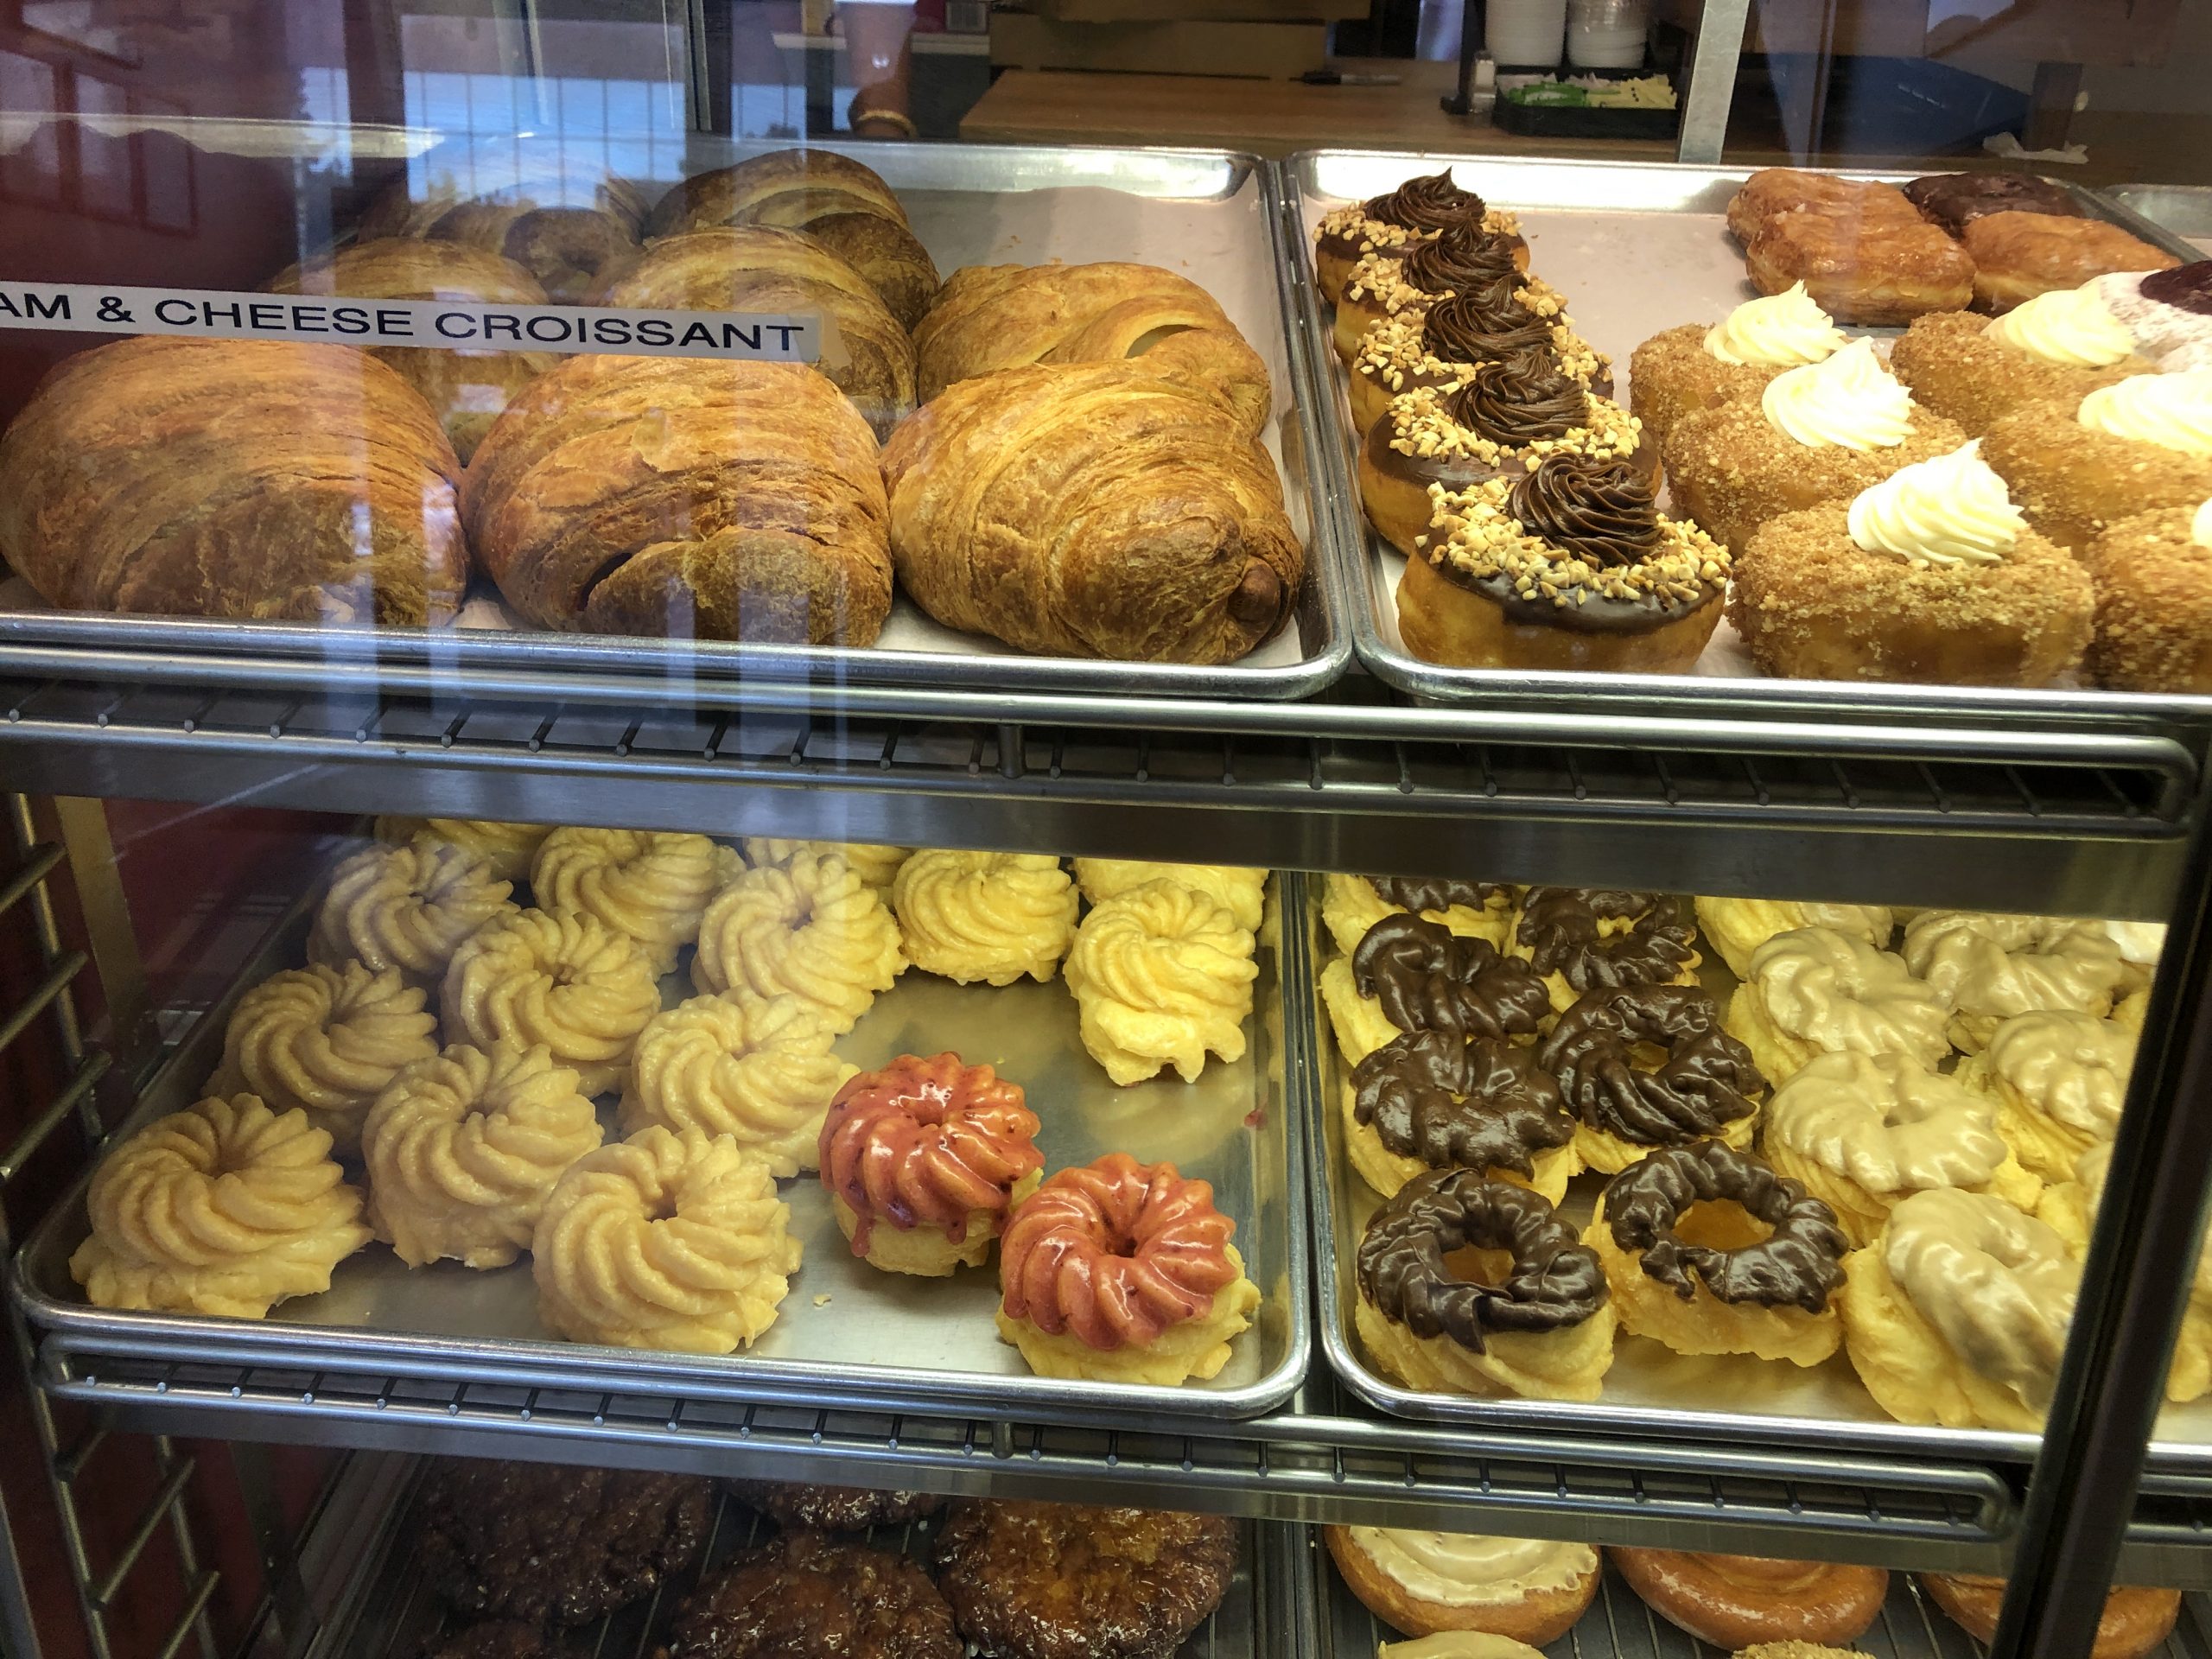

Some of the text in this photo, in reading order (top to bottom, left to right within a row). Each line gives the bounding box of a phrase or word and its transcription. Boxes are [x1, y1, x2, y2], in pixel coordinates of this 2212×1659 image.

[96, 296, 136, 323] &
[155, 299, 414, 336] CHEESE
[435, 312, 804, 351] CROISSANT
